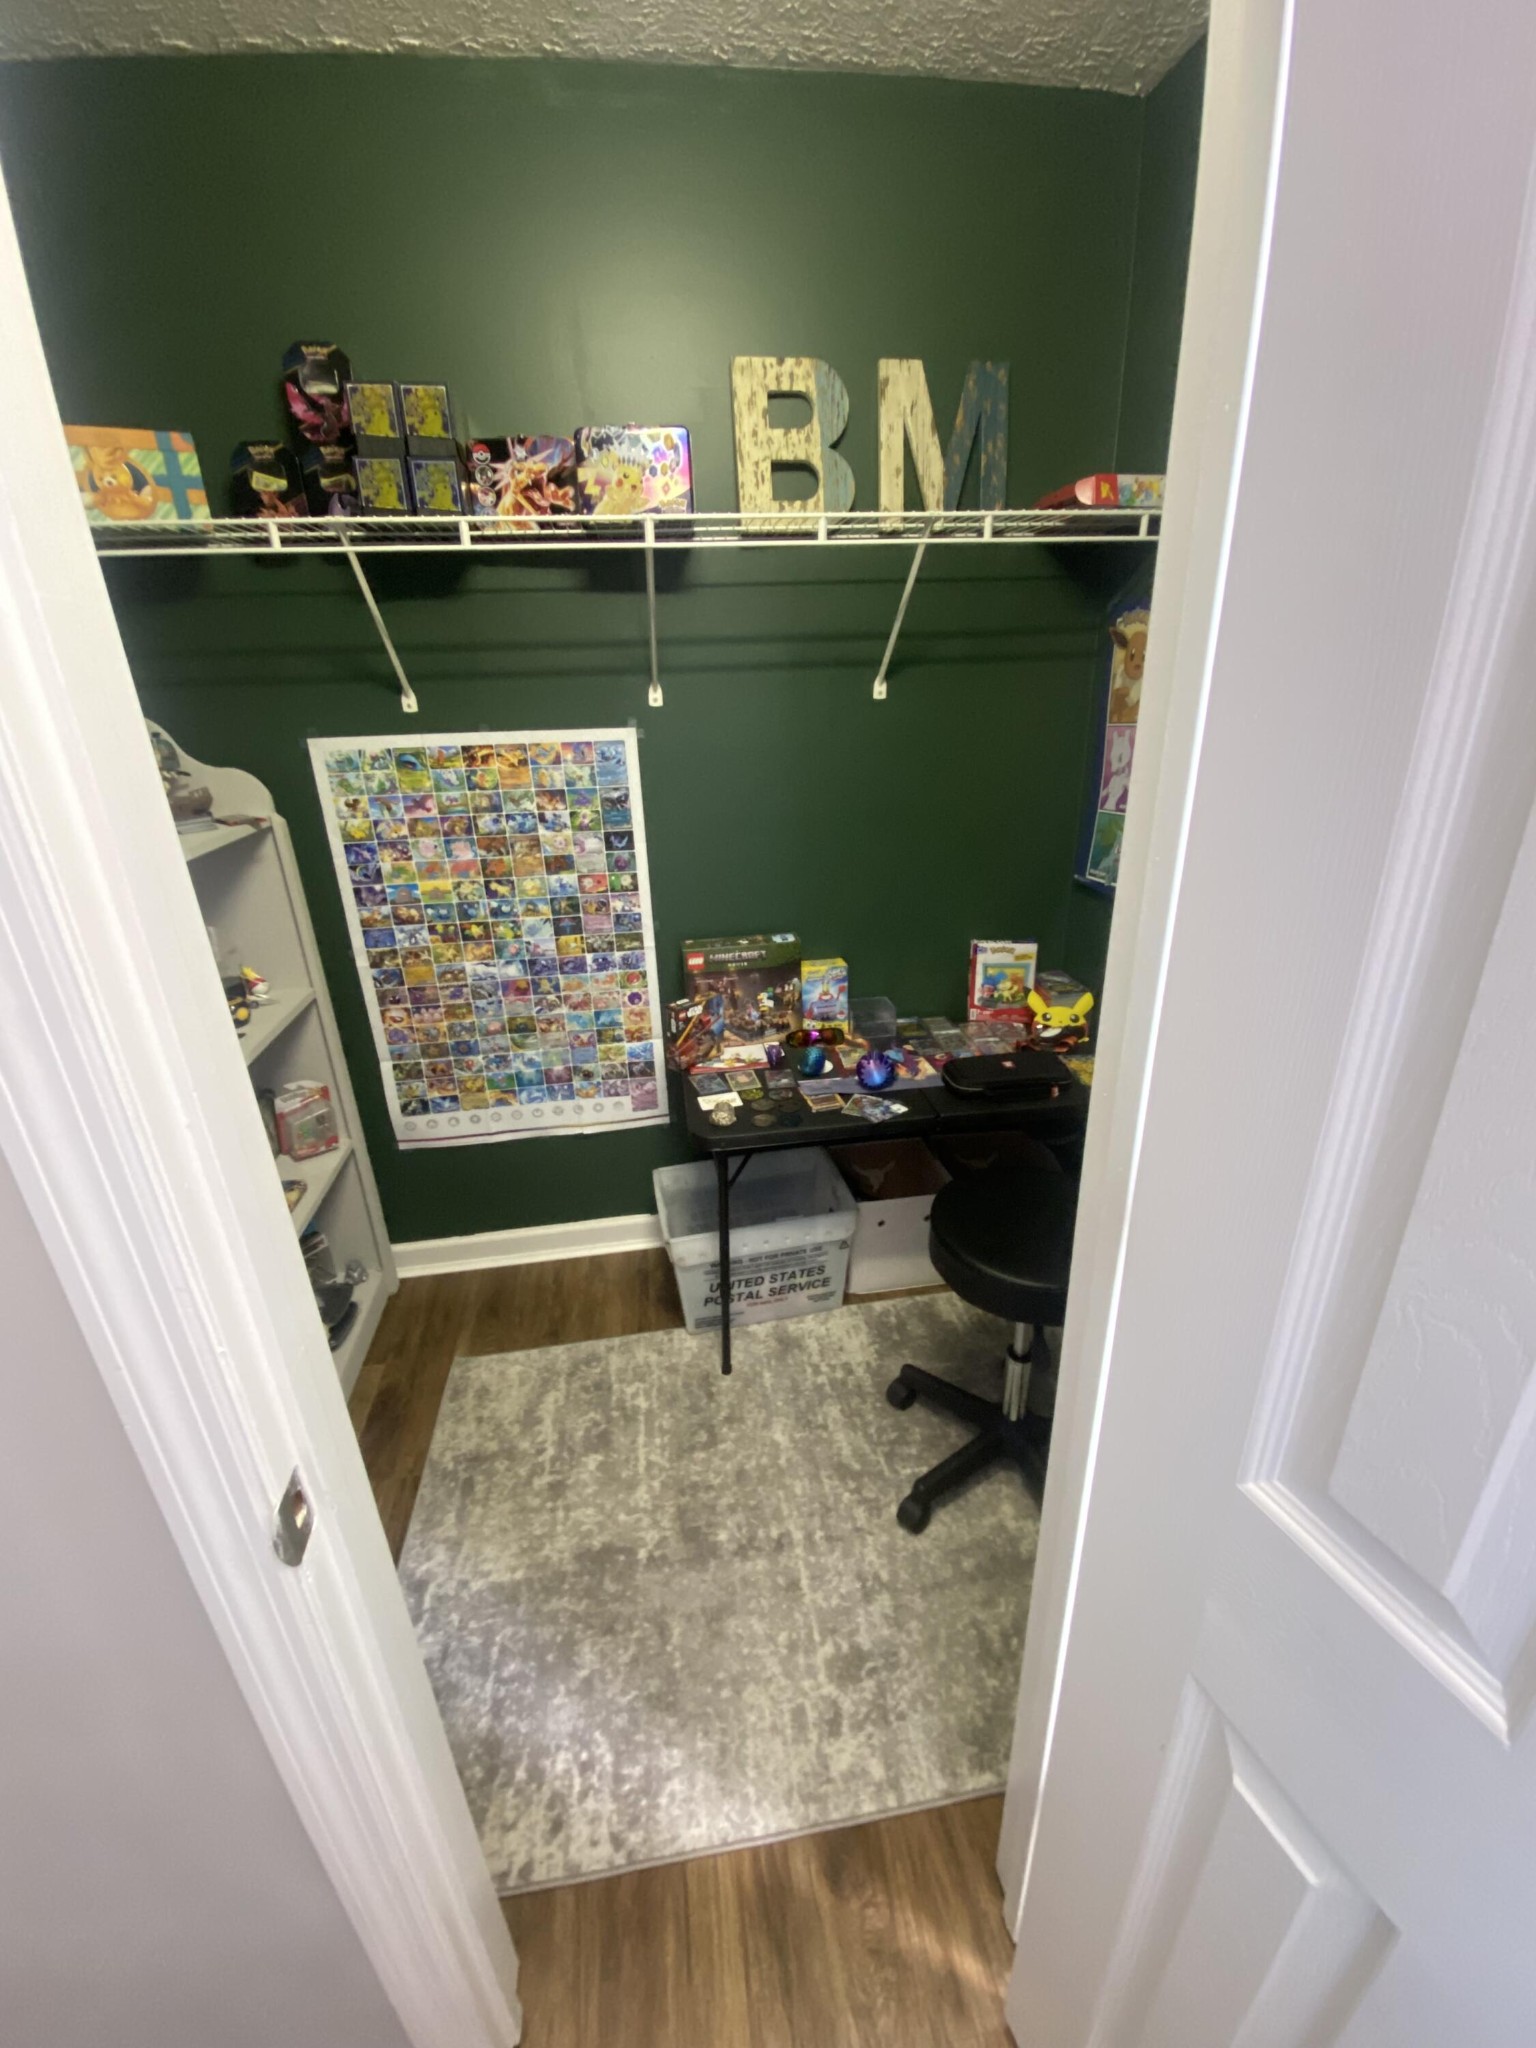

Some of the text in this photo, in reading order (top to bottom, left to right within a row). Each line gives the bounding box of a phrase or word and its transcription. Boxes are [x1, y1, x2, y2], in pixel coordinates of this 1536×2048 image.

[709, 1276, 765, 1294] UITED
[769, 1264, 826, 1284] STATES
[768, 1276, 832, 1297] SERVICE
